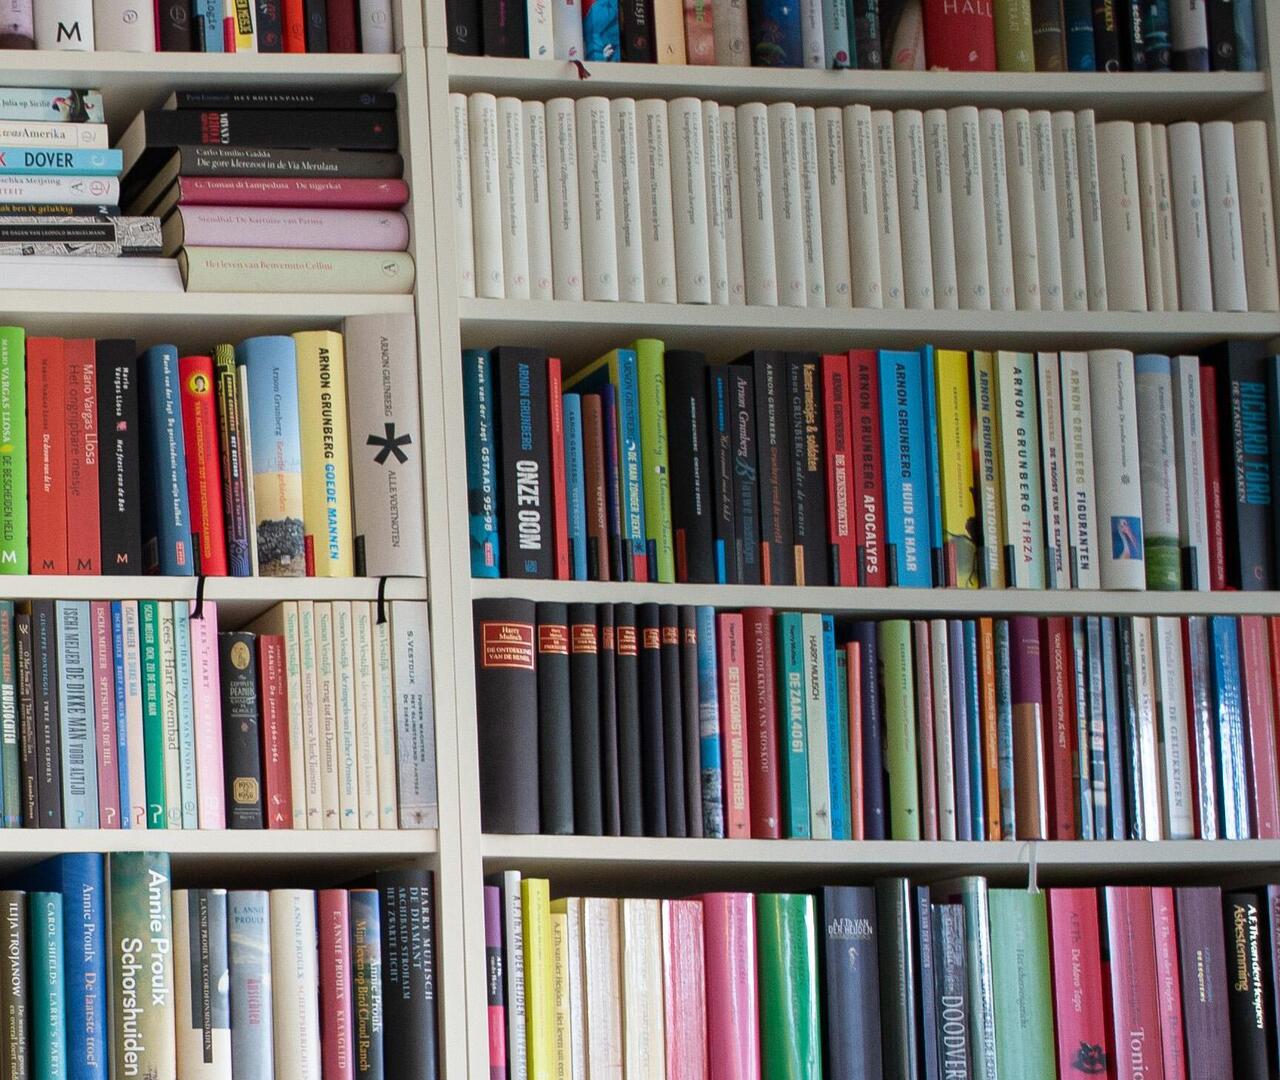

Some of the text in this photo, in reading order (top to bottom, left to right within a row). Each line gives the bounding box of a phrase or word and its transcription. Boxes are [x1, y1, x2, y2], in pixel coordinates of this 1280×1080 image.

[25, 152, 73, 168] DOVER
[318, 348, 340, 559] ARNON GRUNBERG GOEDE MANNEN
[515, 460, 541, 549] ONZE OOM
[863, 495, 877, 573] APOCALYPS
[1021, 521, 1033, 563] TIRZA
[1077, 492, 1090, 570] FIGURANTEN
[66, 668, 85, 740] DE DIKKE MAN
[148, 870, 168, 1005] Annie Proulx
[120, 938, 143, 1076] Schorshuiden
